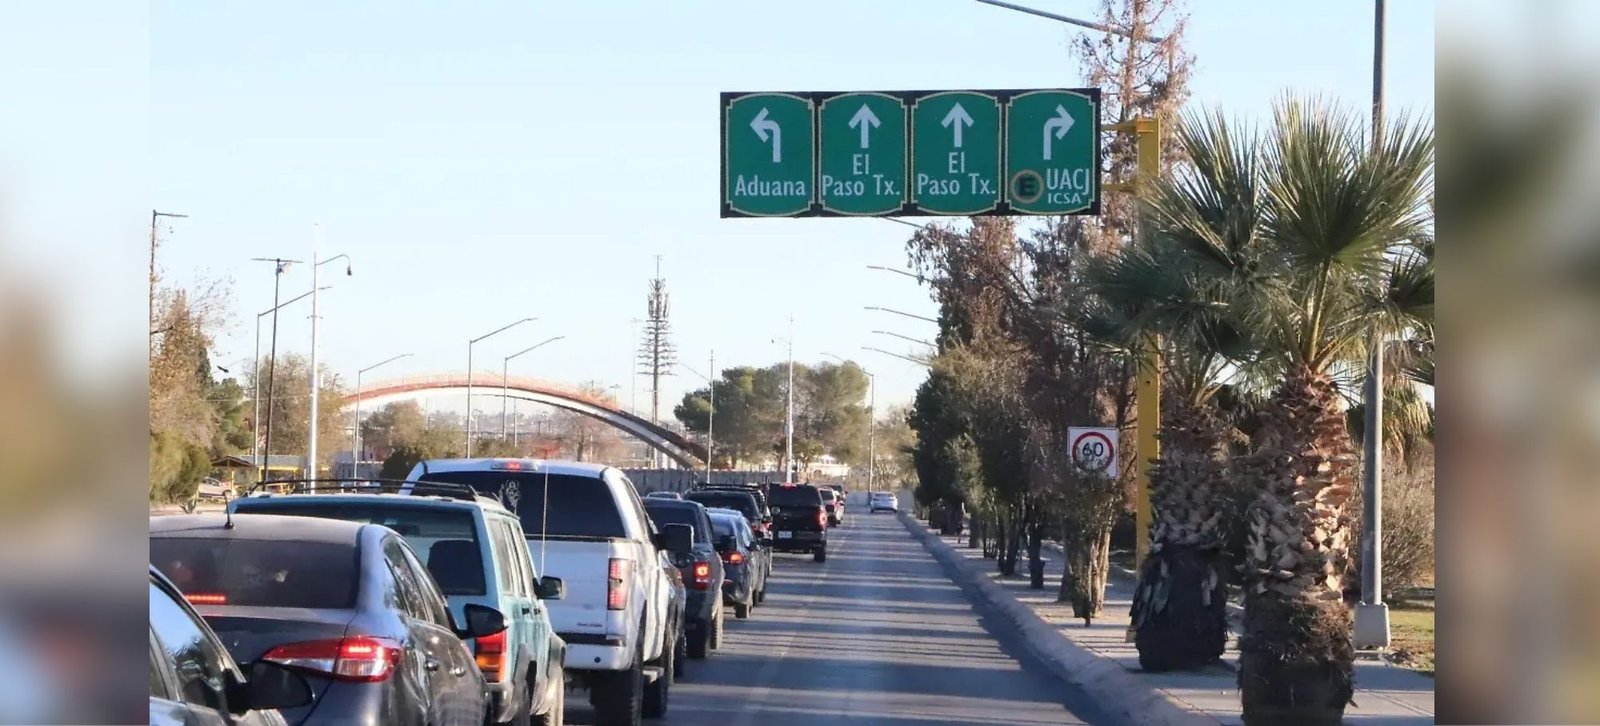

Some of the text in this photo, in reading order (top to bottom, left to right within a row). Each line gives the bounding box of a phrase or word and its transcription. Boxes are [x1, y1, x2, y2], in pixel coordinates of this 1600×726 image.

[852, 153, 870, 175] El
[948, 151, 966, 174] El
[735, 174, 806, 196] Aduana
[822, 174, 900, 196] Paso Tx.
[917, 173, 997, 196] Paso Tx.
[1046, 168, 1090, 196] UACJ
[1047, 192, 1082, 205] ICSA
[1082, 441, 1104, 457] 60
